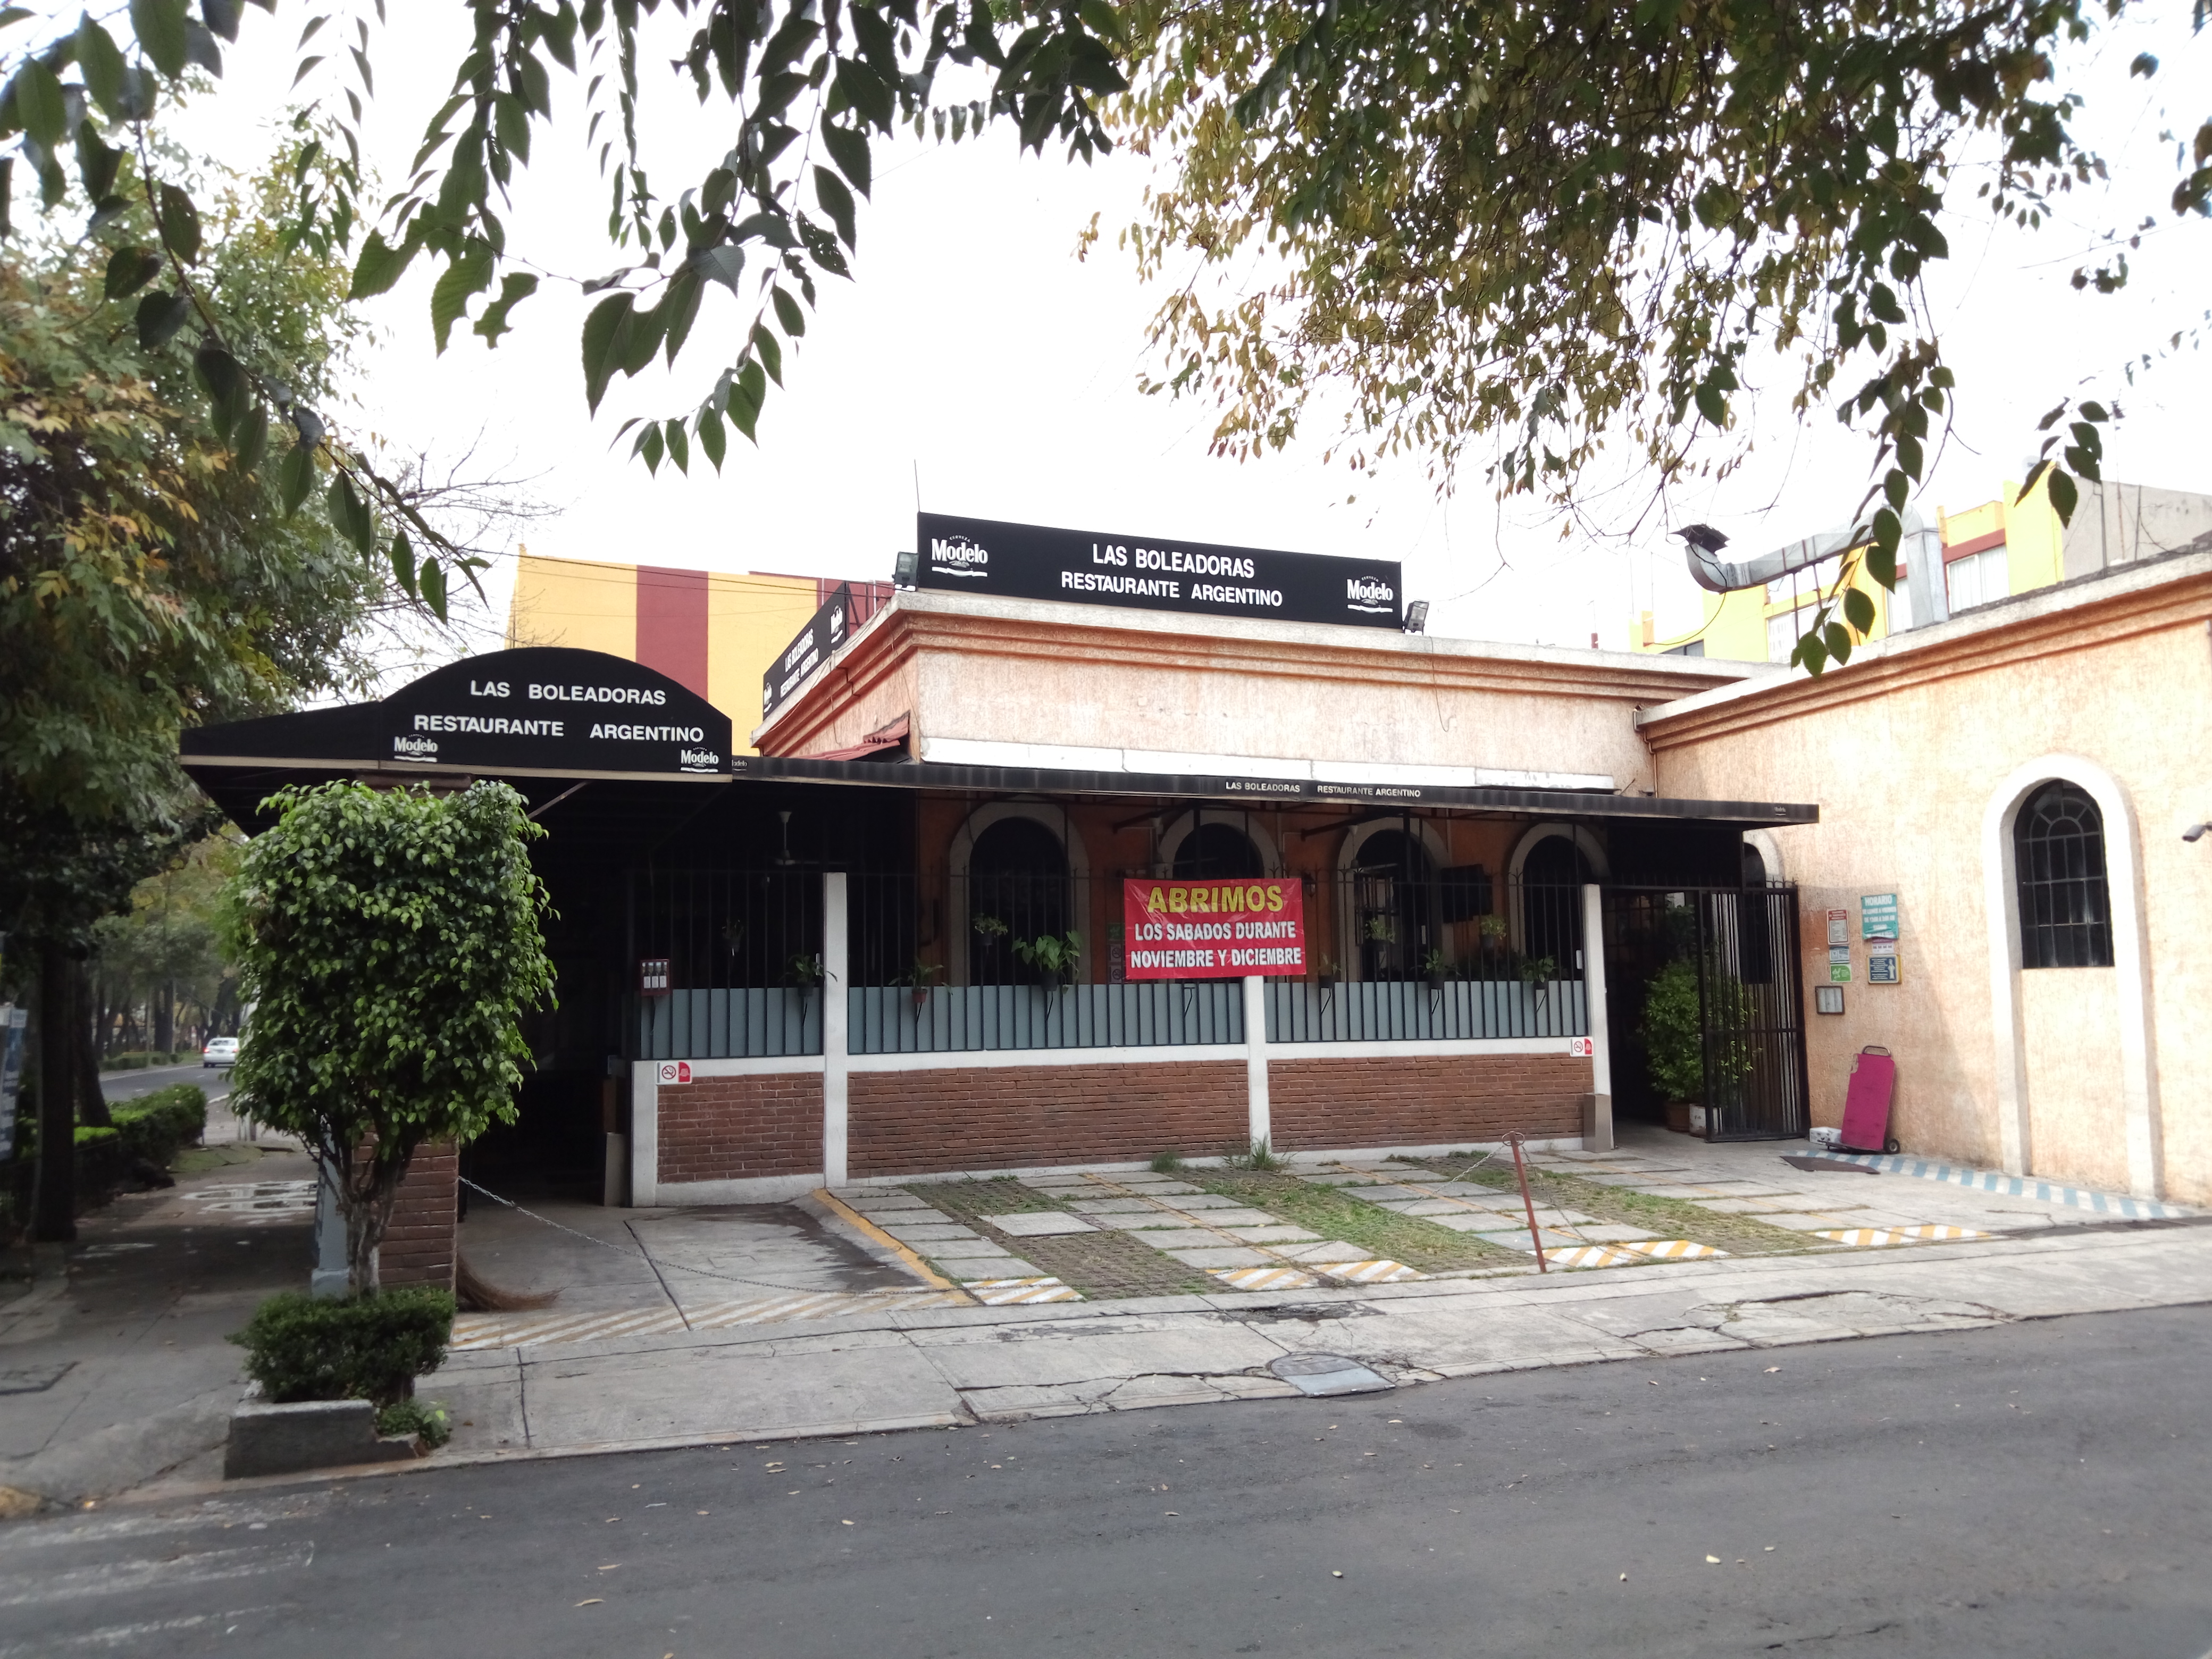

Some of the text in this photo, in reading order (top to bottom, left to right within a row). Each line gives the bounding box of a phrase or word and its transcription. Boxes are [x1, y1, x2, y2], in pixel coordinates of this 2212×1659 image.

[931, 538, 988, 564] Modelo
[1093, 543, 1255, 579] LAS BOLEADORAS
[1061, 571, 1283, 607] RESTAURANTE ARGENTINO
[1347, 579, 1393, 601] Modelo
[471, 680, 666, 705] LAS BOLEADORAS
[414, 715, 703, 742] RESTAURANTE ARGENTINO
[394, 736, 438, 752] Modelo
[681, 749, 719, 765] Modelo
[1245, 782, 1301, 793] BOLEADORAS
[1317, 785, 1421, 798] RESTAURANTE ARGENTINO
[1147, 885, 1284, 913] ABRIMOS
[1865, 894, 1893, 907] HORARIO
[1135, 920, 1296, 941] LOS SABADOS DURANTE
[1130, 946, 1302, 968] NOVIEMBRE Y DICIEMBRE
